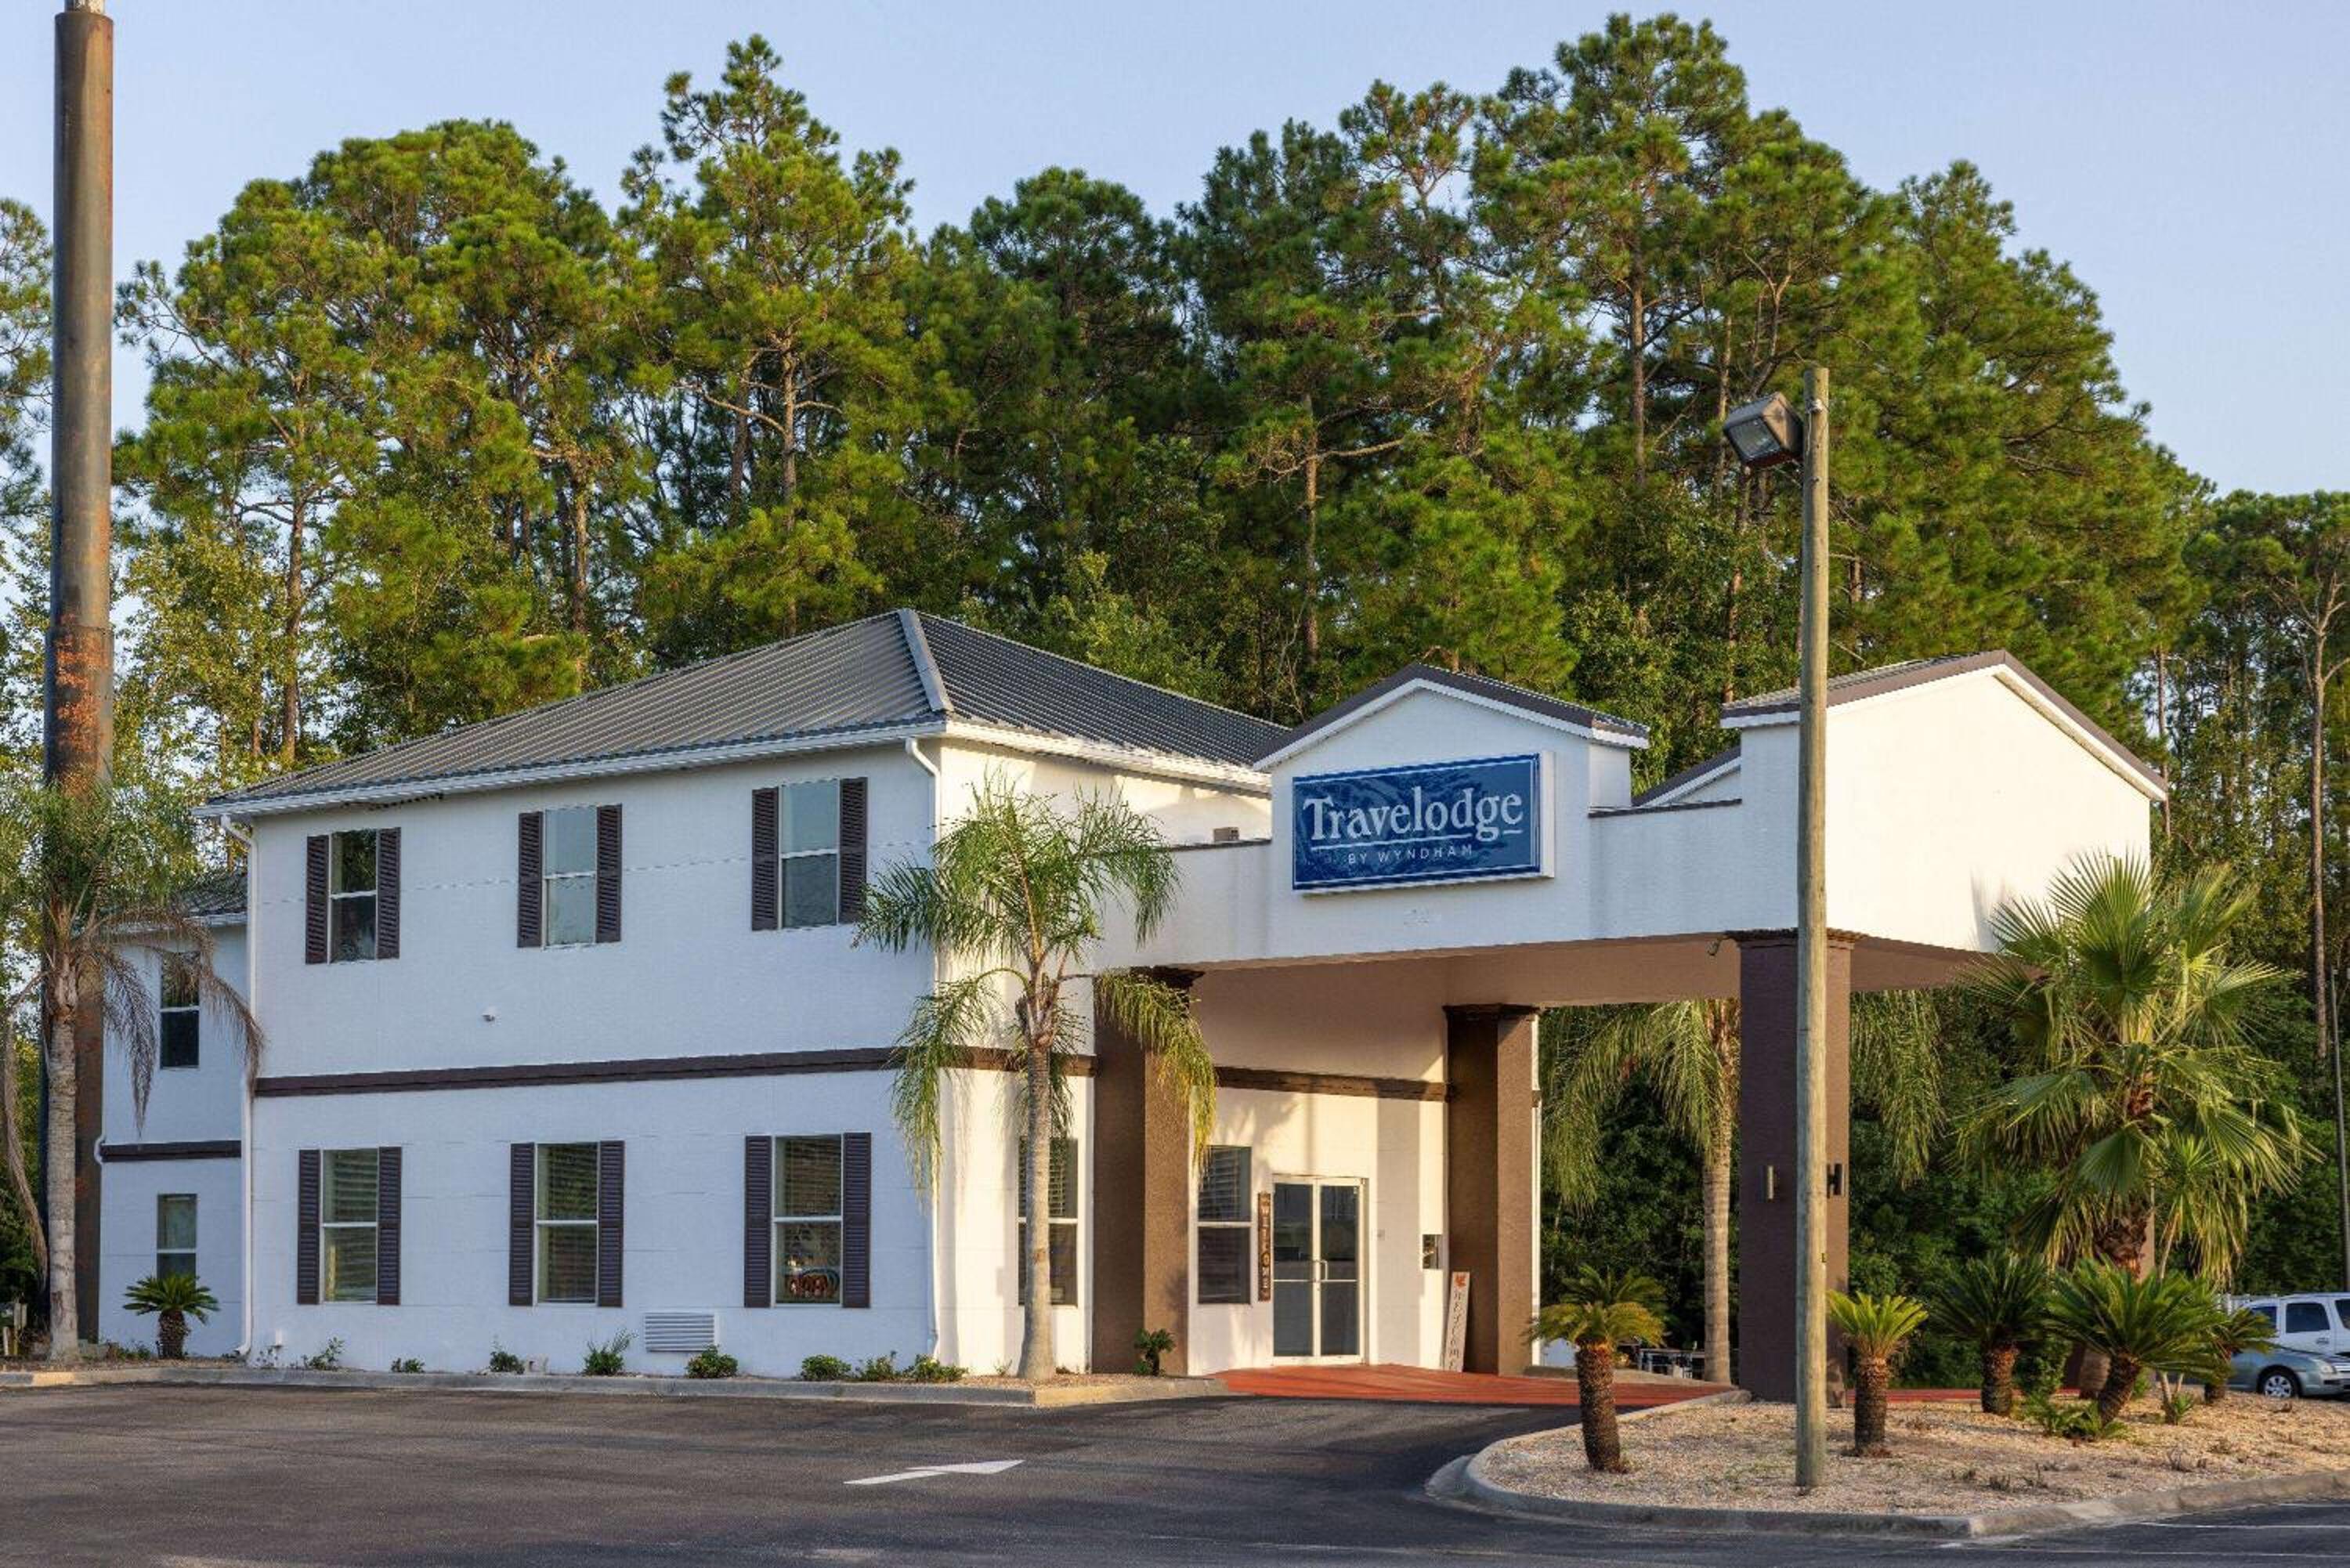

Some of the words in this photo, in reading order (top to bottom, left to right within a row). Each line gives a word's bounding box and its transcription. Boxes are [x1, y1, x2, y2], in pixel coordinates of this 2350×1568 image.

[1303, 786, 1524, 842] Travelodge
[1347, 852, 1368, 864] BY
[1378, 844, 1473, 862] WYNDHAM
